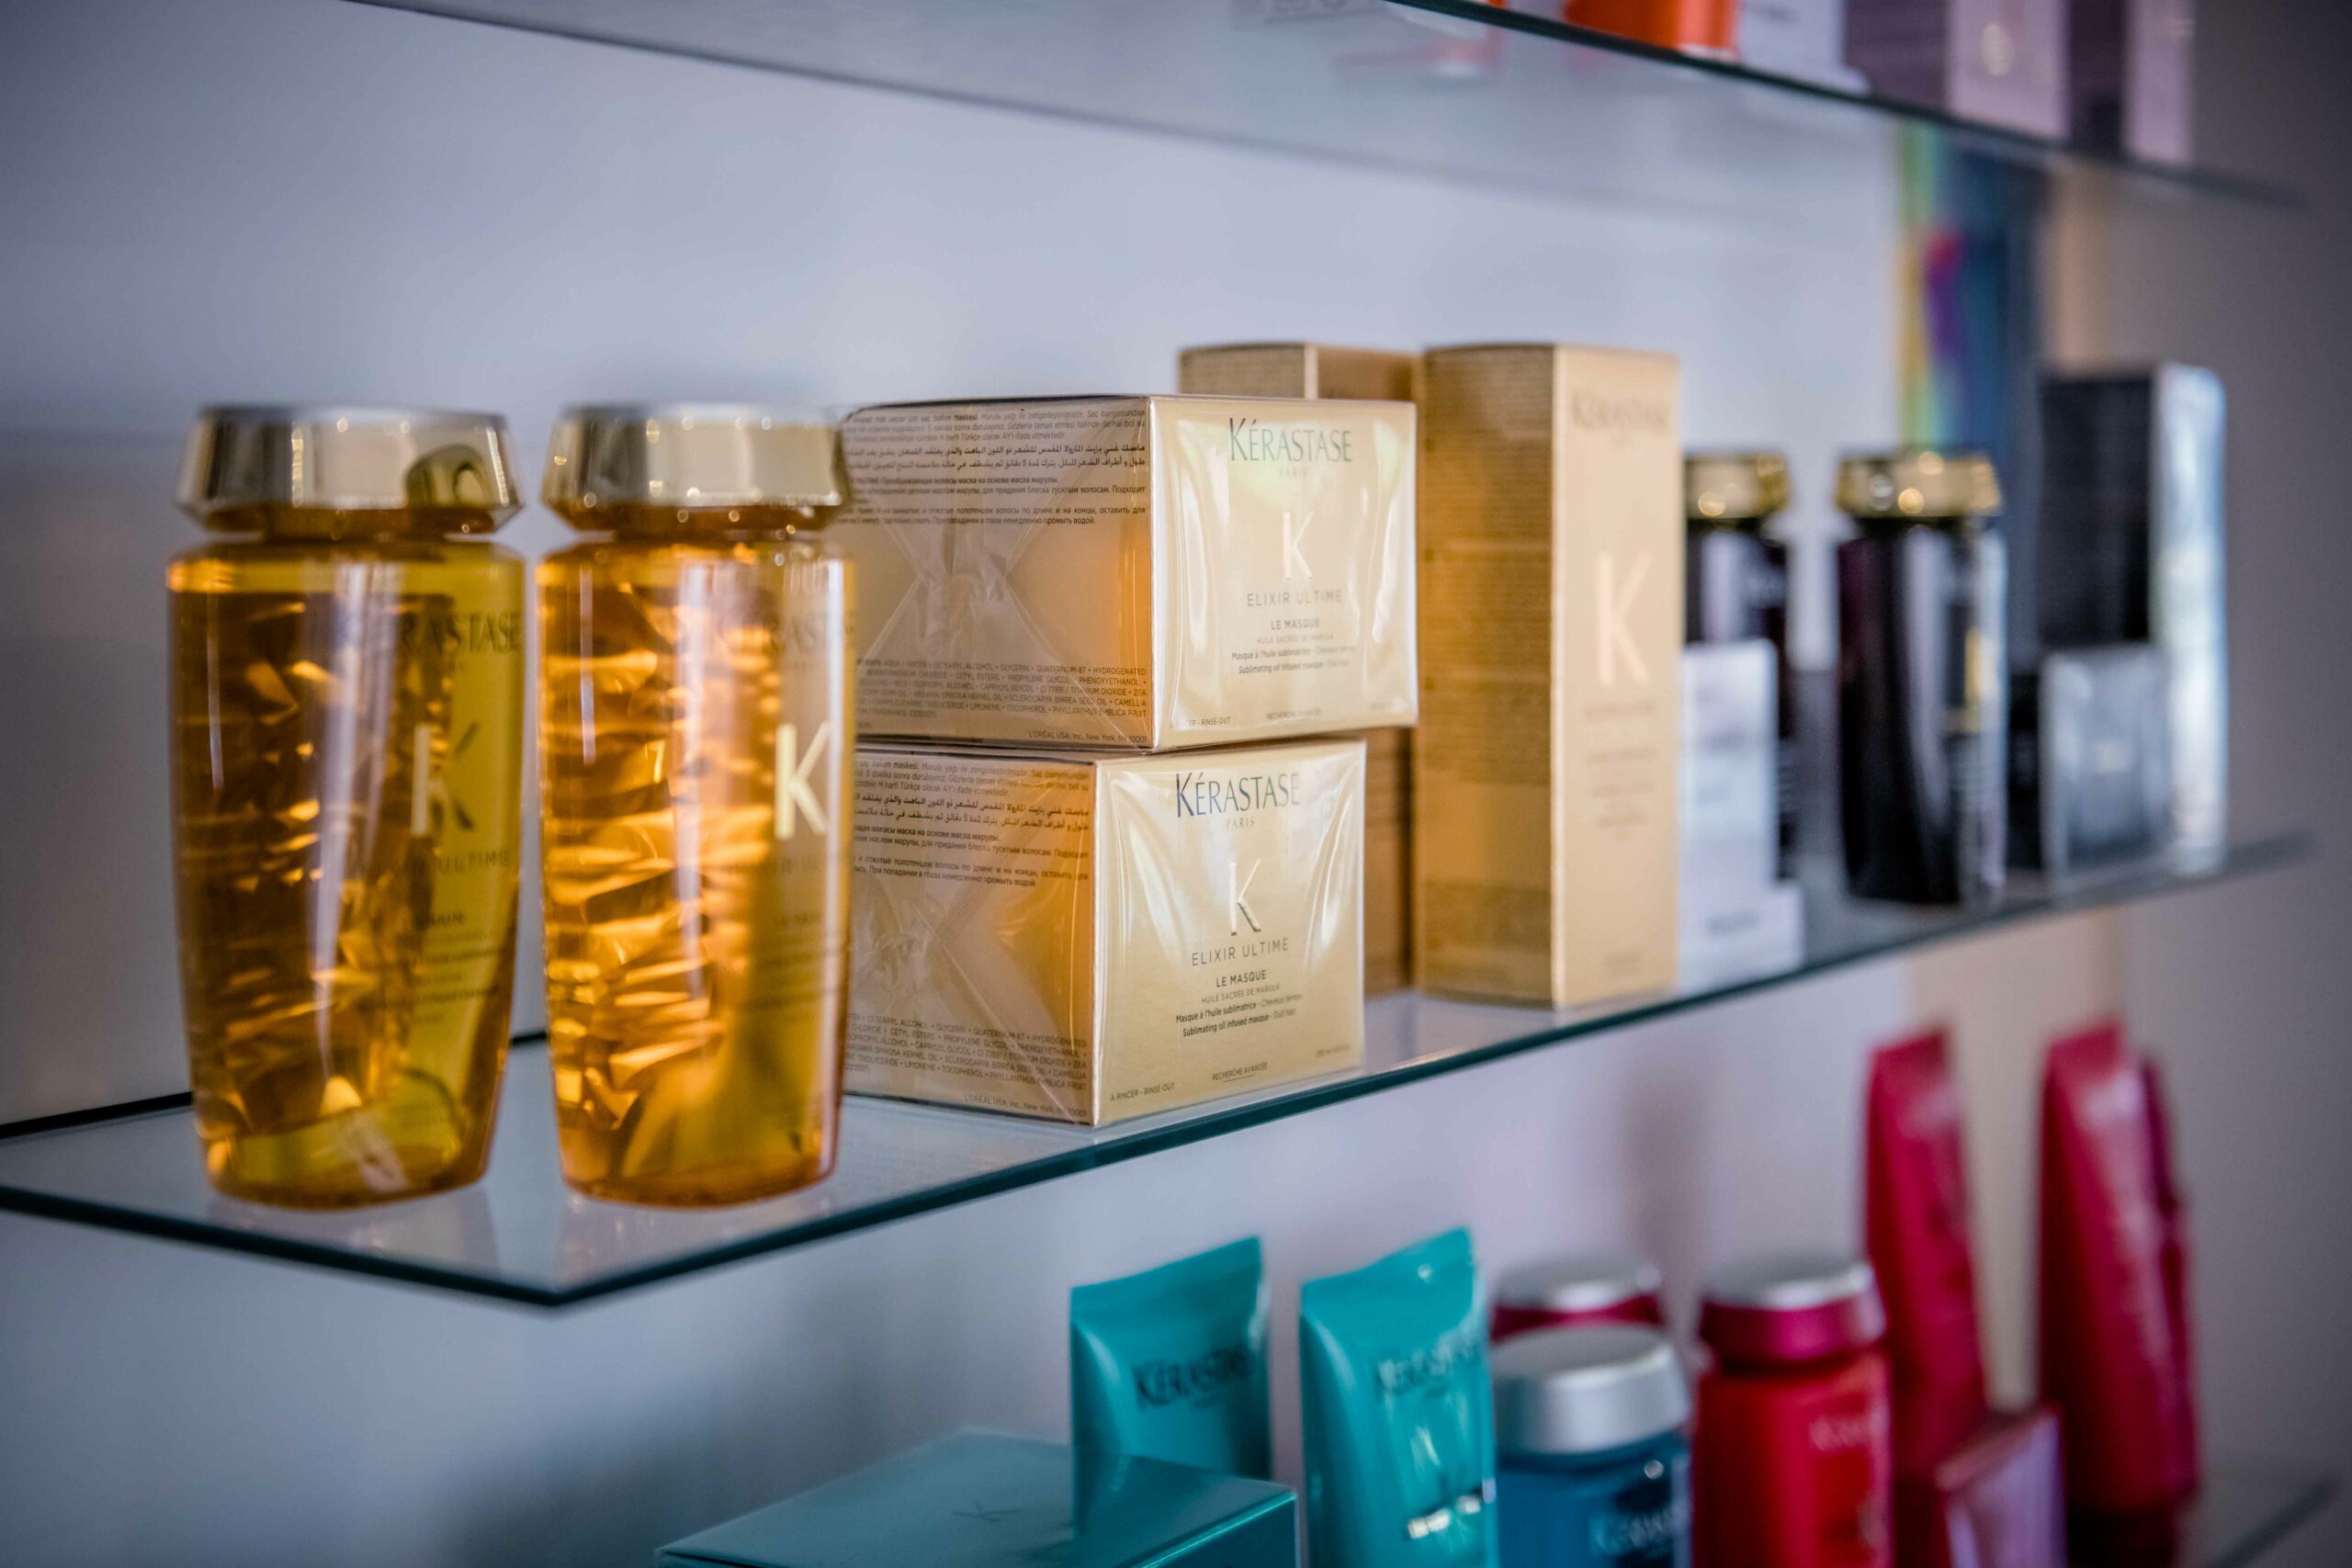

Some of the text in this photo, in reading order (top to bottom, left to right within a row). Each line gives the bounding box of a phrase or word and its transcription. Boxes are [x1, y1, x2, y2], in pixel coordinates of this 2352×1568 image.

[1228, 417, 1352, 462] KÉRASTASE
[1282, 511, 1315, 581] K
[1247, 588, 1343, 607] ELIXIR ULTIME
[1271, 617, 1320, 630] LE MASQUE
[1598, 551, 1650, 686] K
[1231, 650, 1254, 660] Masque
[1093, 667, 1146, 675] HYDROGENATED
[1238, 662, 1272, 675] Sublimating
[1080, 676, 1139, 685] PHENOXYETHANOL
[1201, 716, 1231, 728] RINSE-OUT
[774, 721, 833, 840] K
[1176, 772, 1300, 818] KÉRASTASE
[1226, 817, 1254, 829] PARIS
[1228, 859, 1261, 936] K
[1192, 938, 1289, 966] ELIXIR ULTIME
[1216, 969, 1267, 988] LE MASQUE
[1202, 995, 1219, 1005] HUILE
[1221, 989, 1245, 1002] SACRÉE
[1176, 1011, 1198, 1024] Masque
[1200, 1010, 1204, 1019] à
[1205, 1007, 1222, 1018] l'huile
[1223, 1001, 1256, 1015] sublimatrice
[1182, 1021, 1216, 1037] Sublimating
[1227, 1016, 1247, 1028] infused
[1248, 1013, 1270, 1026] masque
[1212, 1069, 1243, 1081] RECHERCHE
[1144, 1082, 1174, 1096] RINSE-OUT
